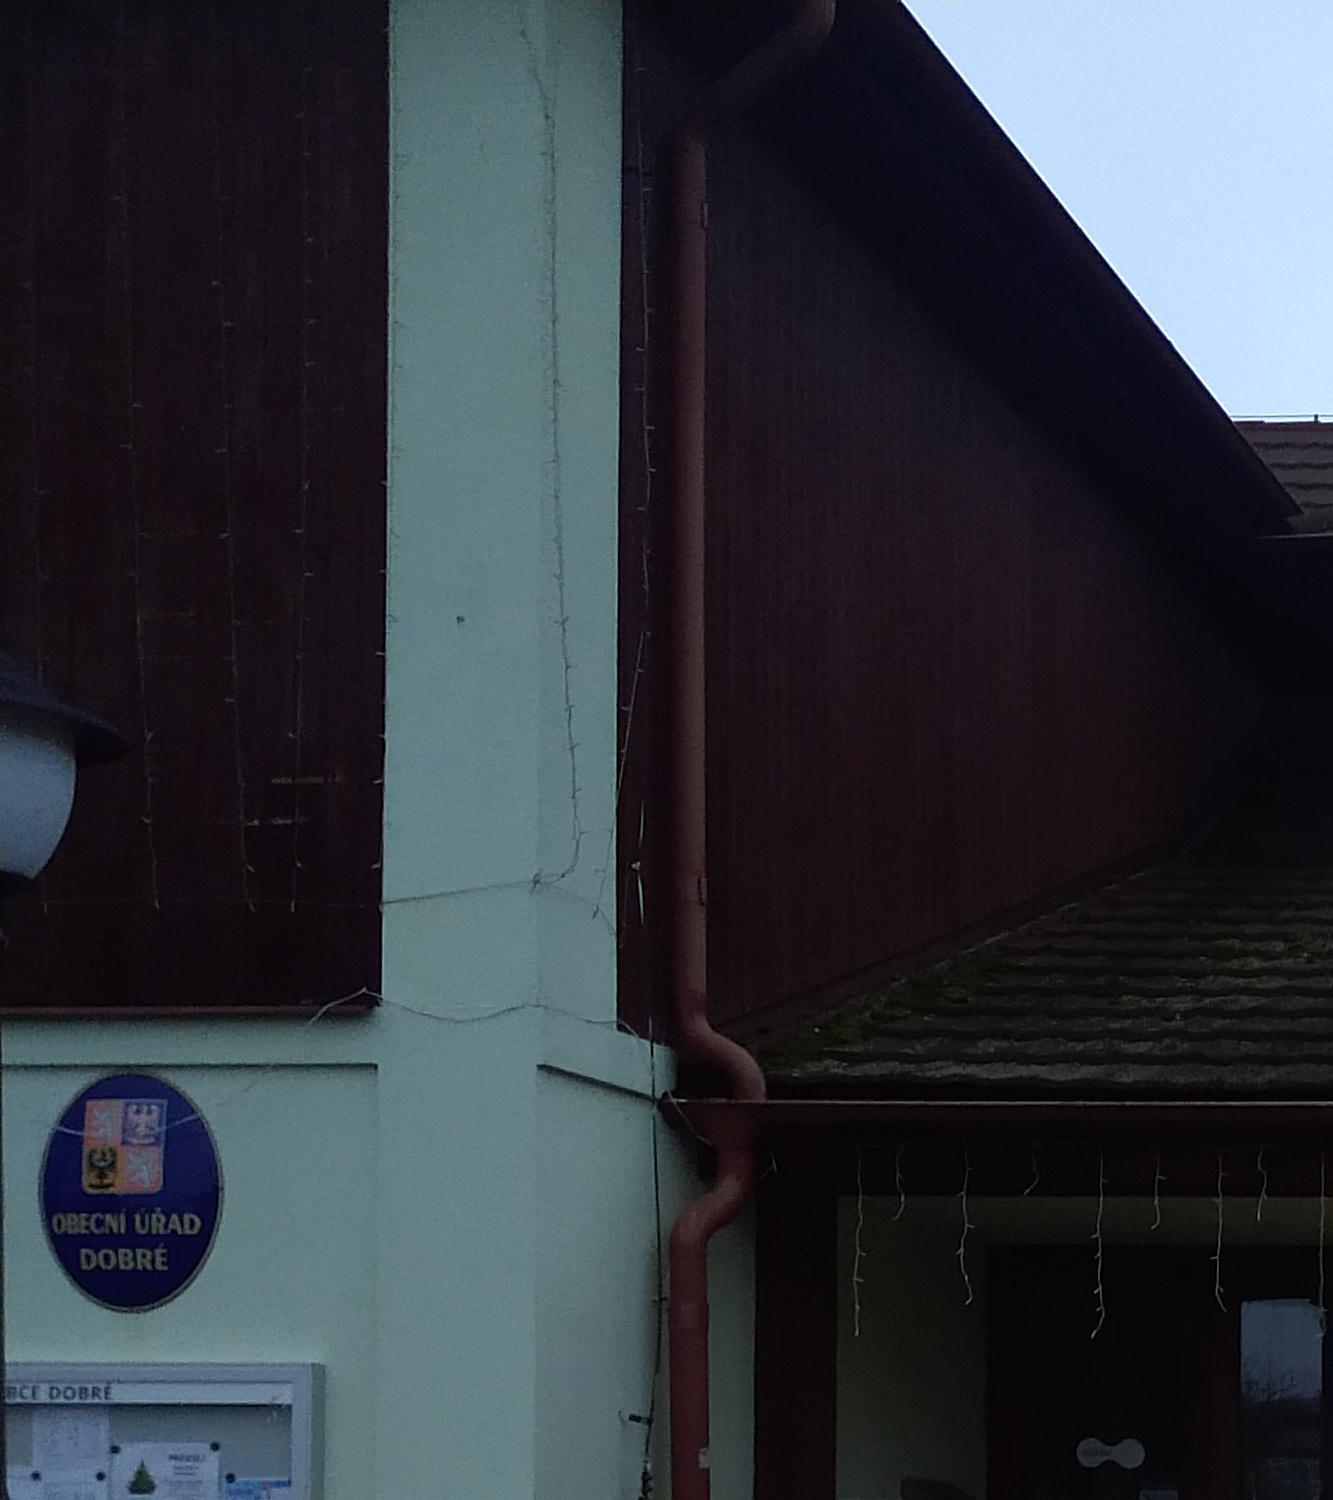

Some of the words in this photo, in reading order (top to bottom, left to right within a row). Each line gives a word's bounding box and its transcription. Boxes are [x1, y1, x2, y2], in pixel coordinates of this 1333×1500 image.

[51, 1208, 127, 1235] OBECNÍ
[133, 1207, 203, 1236] ÚŘAD
[78, 1242, 169, 1271] DOBRÉ
[6, 1386, 38, 1400] BCE
[49, 1383, 112, 1401] DOBRÉ
